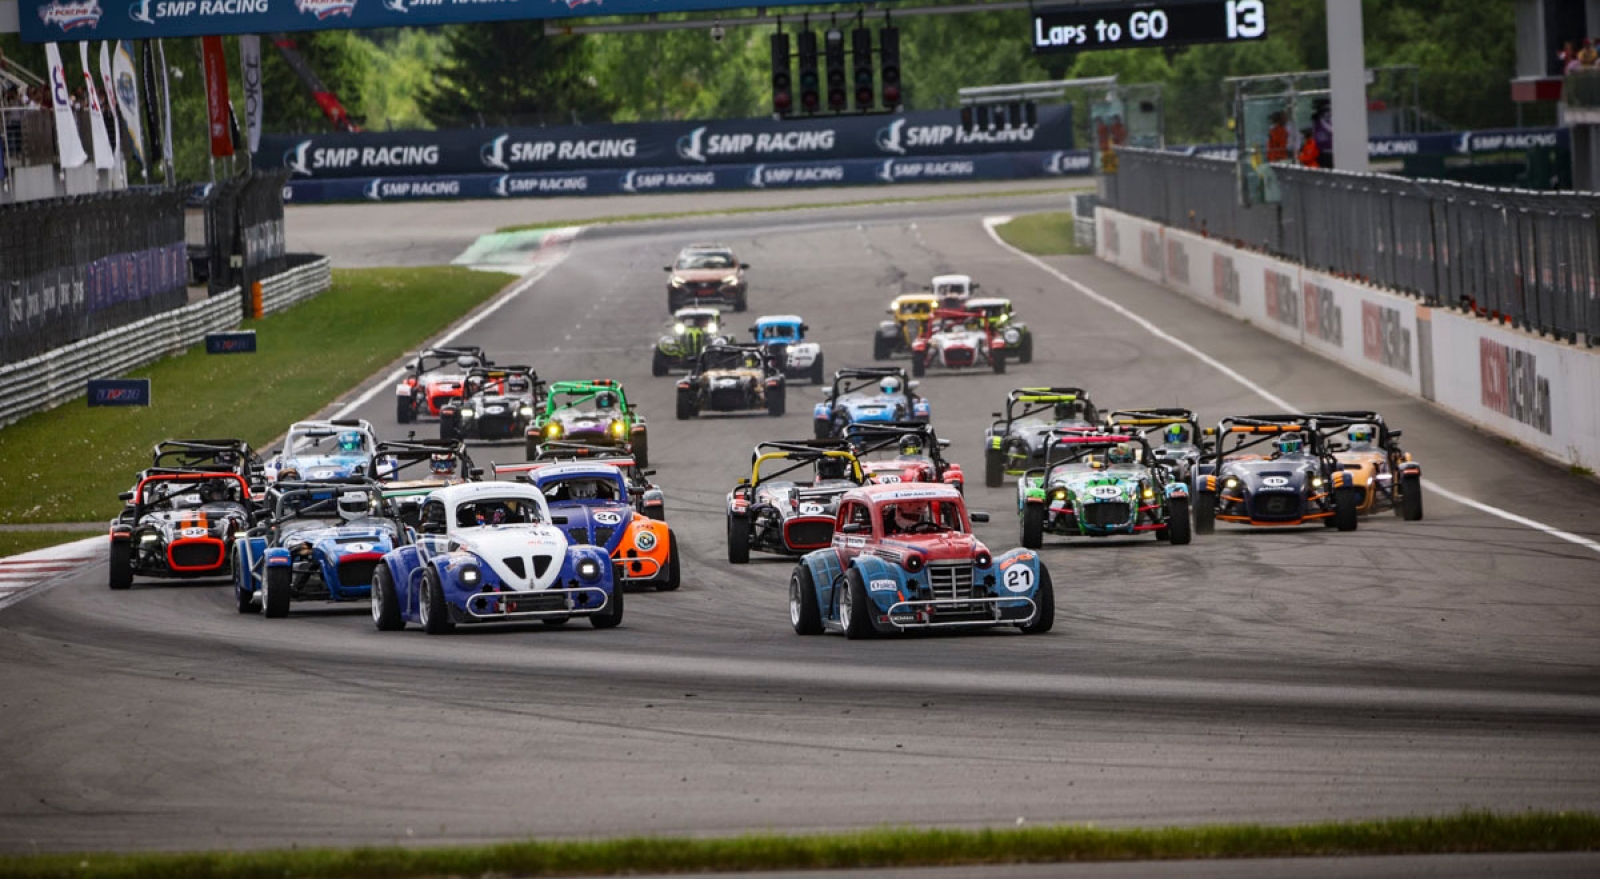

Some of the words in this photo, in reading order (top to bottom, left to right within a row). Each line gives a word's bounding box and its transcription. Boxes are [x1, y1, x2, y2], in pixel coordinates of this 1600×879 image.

[155, 1, 196, 17] SMP
[199, 0, 269, 15] RACING
[1035, 17, 1086, 46] Laps
[1095, 19, 1121, 42] to
[1129, 10, 1168, 40] GO
[1226, 0, 1266, 38] 13
[707, 134, 753, 155] SMP
[755, 130, 835, 152] RACING
[906, 125, 953, 146] SMP
[1472, 136, 1504, 149] SMP
[1505, 133, 1556, 147] RACING
[312, 147, 359, 168] SMP
[361, 145, 439, 167] RACING
[510, 141, 556, 162] SMP
[558, 138, 637, 159] RACING
[764, 169, 794, 183] SMP
[795, 166, 844, 181] RACING
[894, 163, 923, 177] SMP
[924, 161, 974, 175] RACING
[382, 183, 410, 196] SMP
[411, 180, 460, 195] RACING
[509, 178, 538, 192] SMP
[539, 176, 587, 191] RACING
[636, 174, 665, 188] SMP
[666, 172, 715, 186] RACING
[597, 513, 618, 522] 24
[1007, 570, 1031, 587] 21
